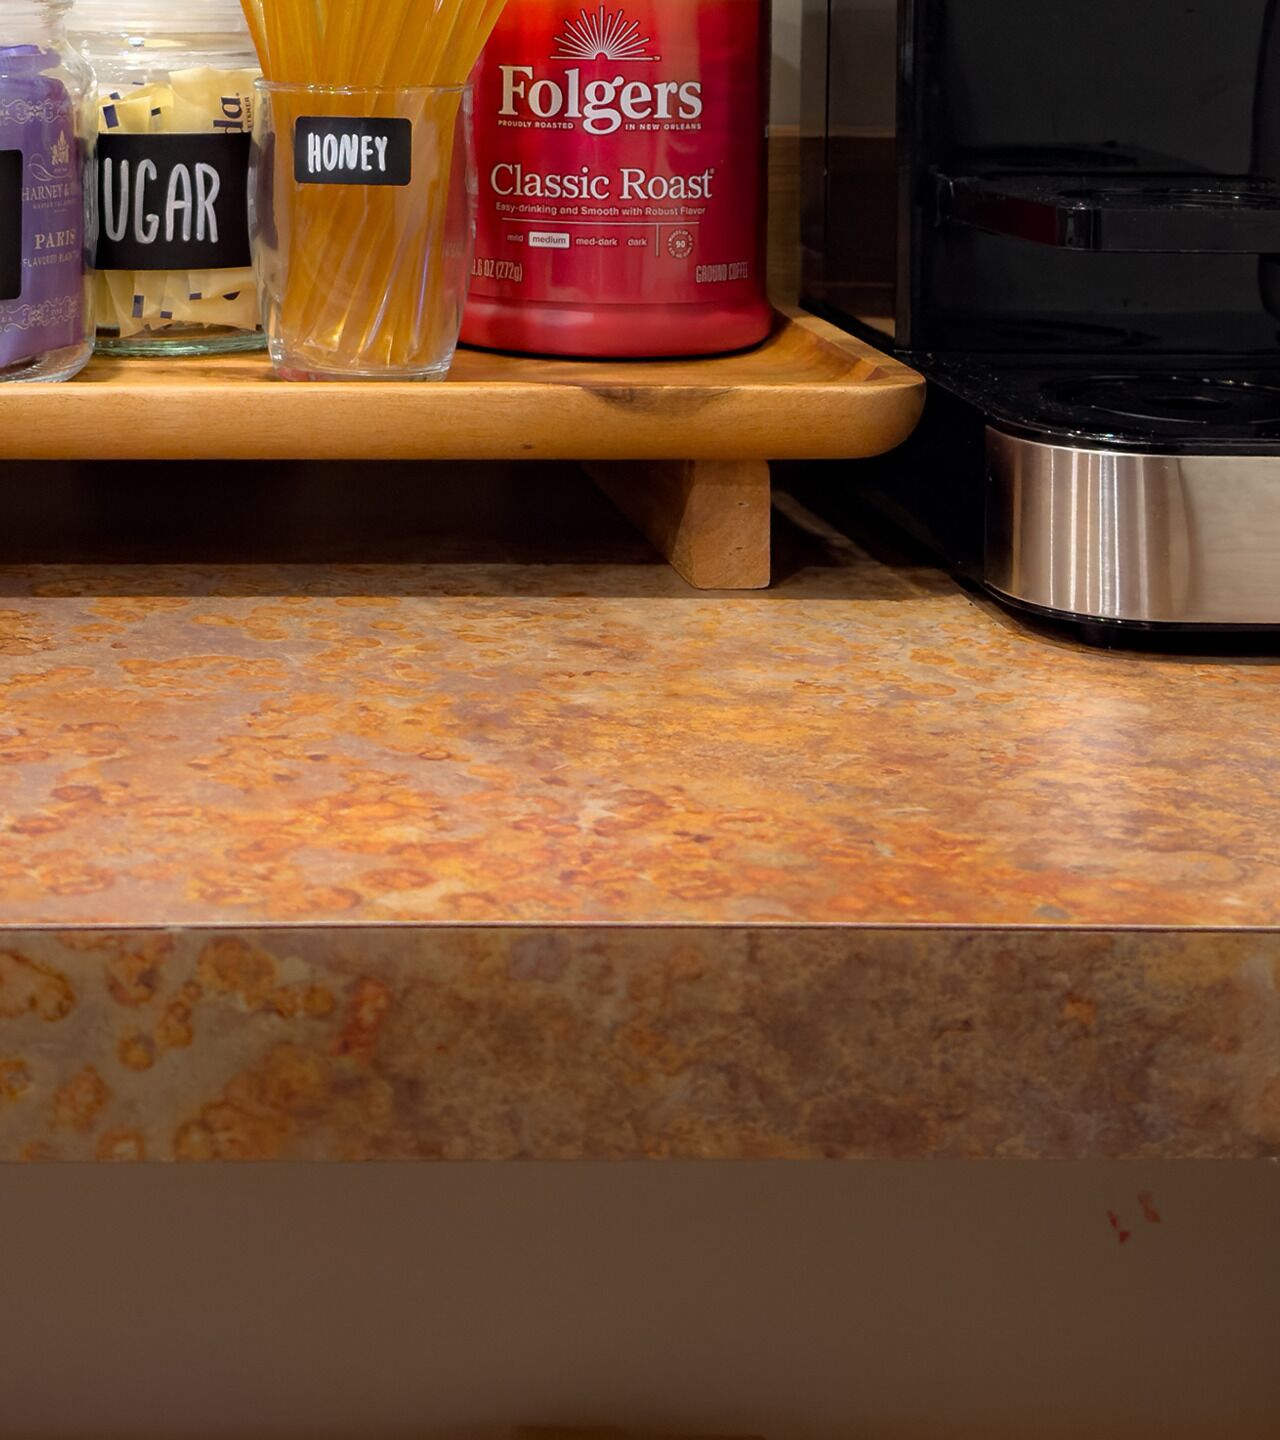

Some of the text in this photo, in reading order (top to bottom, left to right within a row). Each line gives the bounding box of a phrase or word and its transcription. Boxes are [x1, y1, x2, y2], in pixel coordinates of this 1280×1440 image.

[498, 64, 703, 136] Folgers
[498, 119, 574, 130] PROUDLY ROASTED
[625, 122, 702, 131] IN NEW ORLEANS
[307, 131, 389, 174] HONEY
[490, 163, 713, 200] Classic Roast
[22, 184, 62, 201] HARNEY
[103, 157, 221, 244] UGAR
[495, 201, 706, 216] Easy-drinking and Smooth with Robust Flavor
[34, 228, 76, 250] PARIS
[507, 233, 647, 247] mild medium med-dark dark
[675, 240, 686, 249] 90
[483, 258, 495, 278] OZ
[496, 260, 523, 282] (272g)
[696, 263, 728, 283] GROUND
